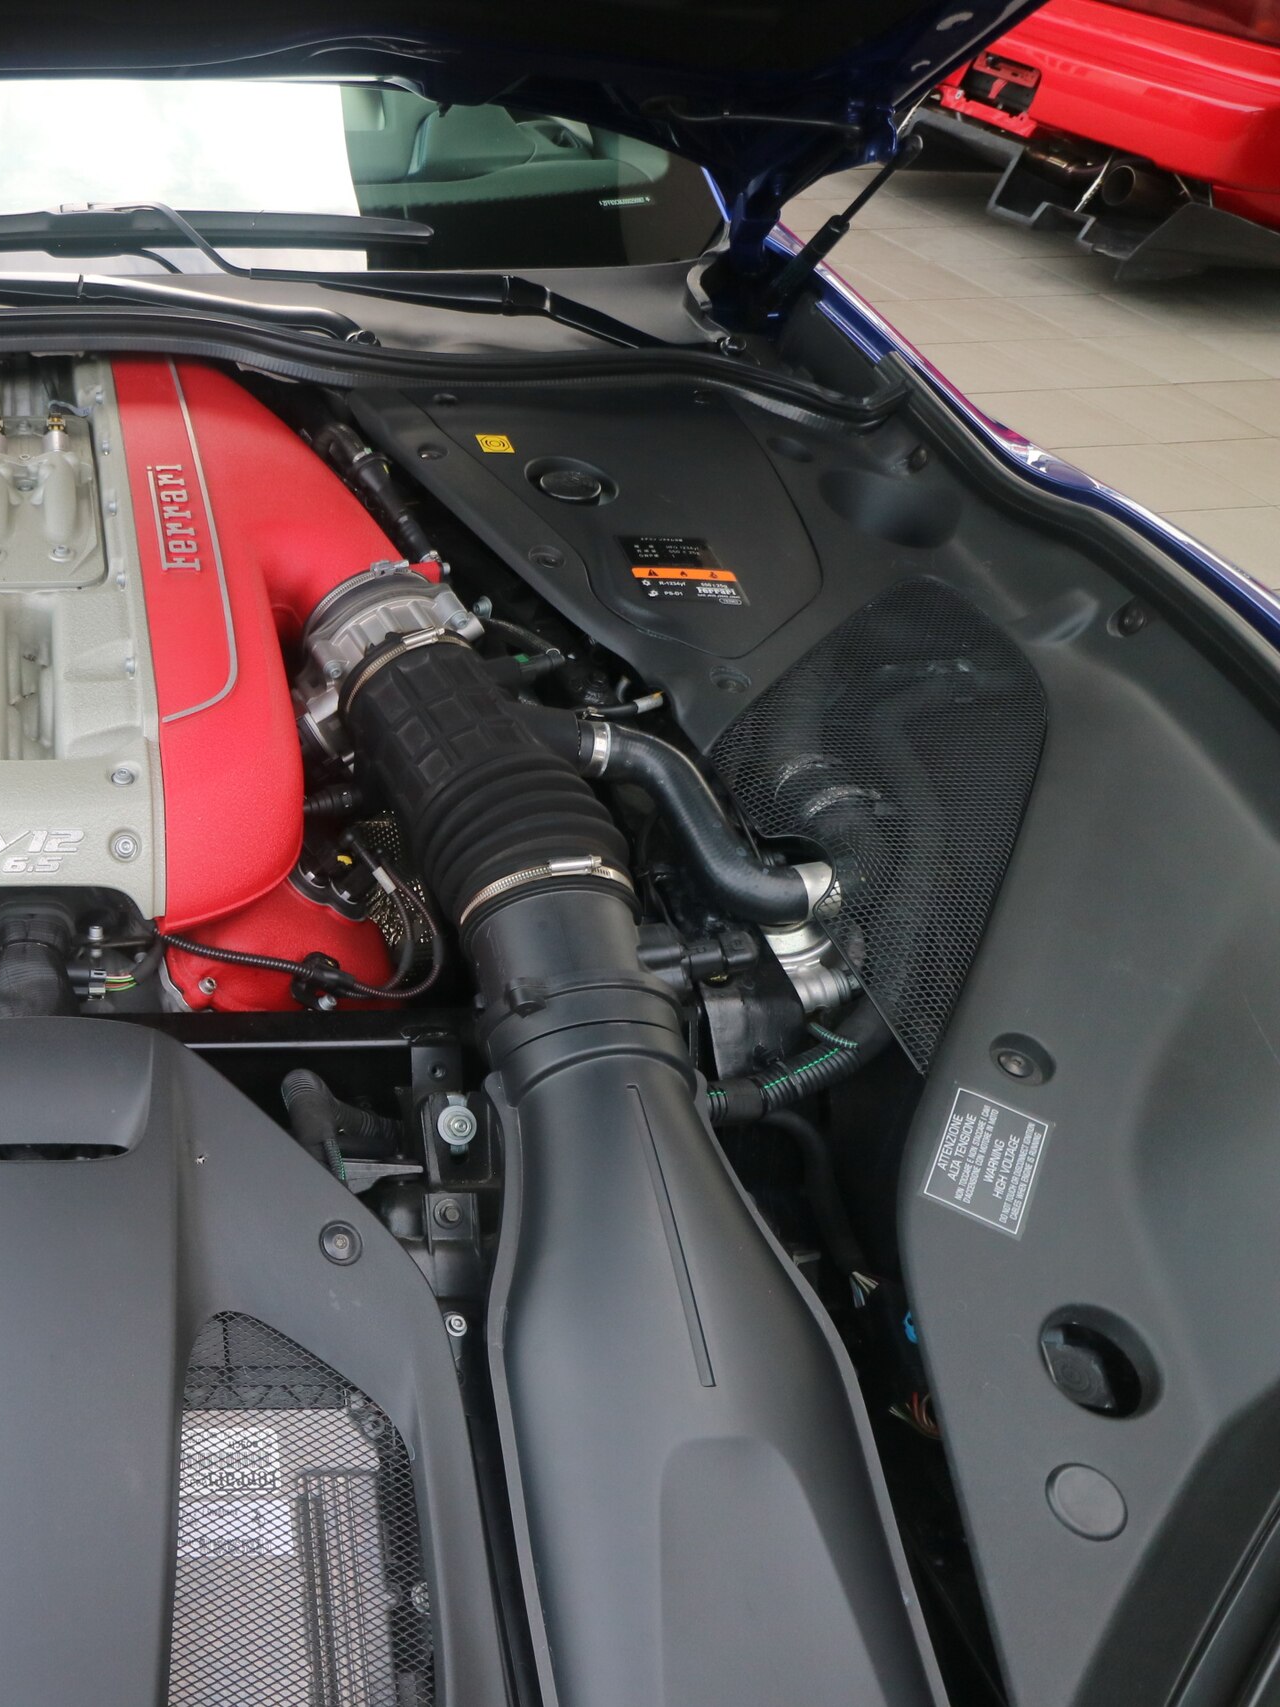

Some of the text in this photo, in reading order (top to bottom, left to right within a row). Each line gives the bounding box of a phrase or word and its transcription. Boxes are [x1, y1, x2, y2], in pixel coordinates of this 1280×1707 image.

[147, 463, 200, 573] Ferrari
[695, 586, 737, 596] Ferrari
[2, 856, 64, 873] 6.5
[937, 1114, 963, 1170] ATTENZIONE
[972, 1120, 986, 1146] STACCARE
[979, 1131, 991, 1154] MOTORE
[947, 1113, 977, 1181] ALTA TENSIONE
[968, 1146, 977, 1159] NON
[983, 1138, 1005, 1184] WARNING
[993, 1134, 1020, 1199] HIGH VOLTAGE
[959, 1163, 972, 1187] TOCCARE
[1011, 1176, 1019, 1185] OR
[955, 1187, 964, 1200] NON
[1006, 1184, 1016, 1203] TOUCH
[1010, 1199, 1021, 1220] CABLES
[1021, 1163, 1032, 1183] ENGINE
[1002, 1202, 1011, 1214] NOT
